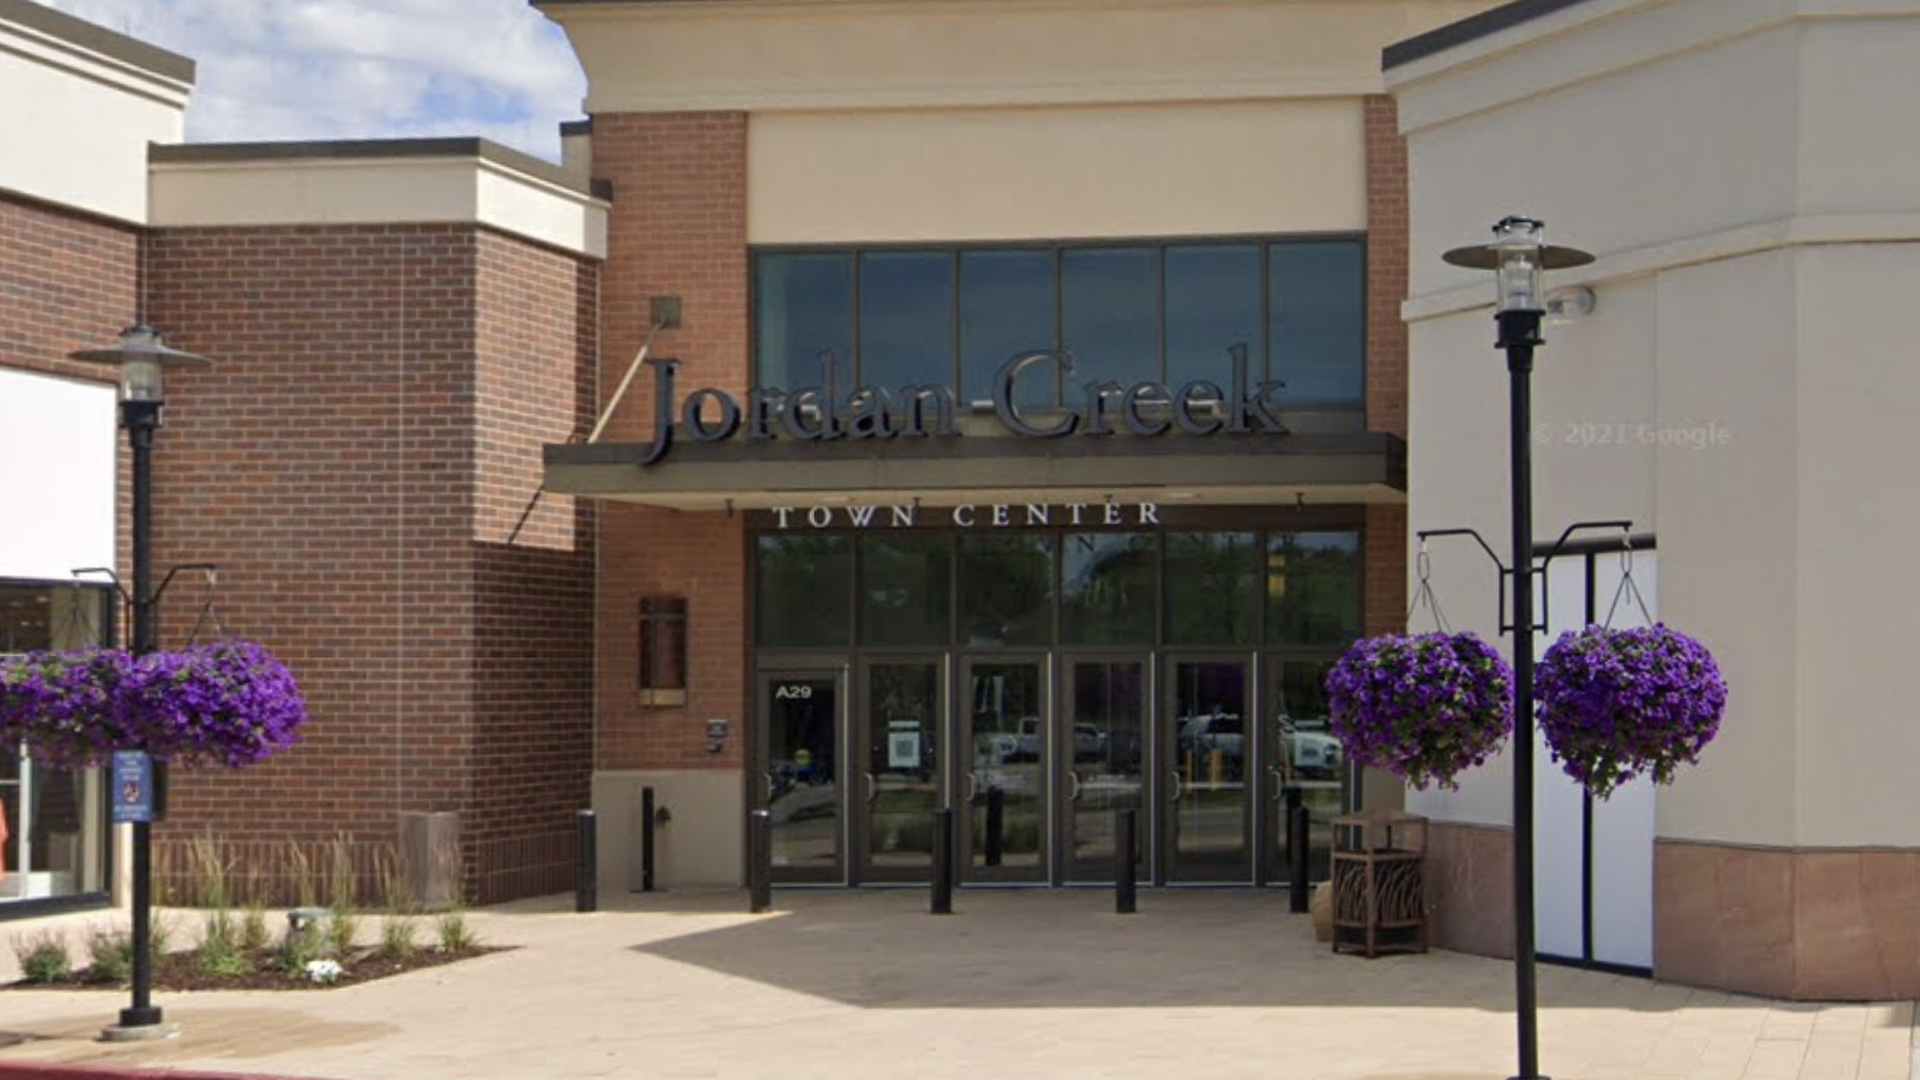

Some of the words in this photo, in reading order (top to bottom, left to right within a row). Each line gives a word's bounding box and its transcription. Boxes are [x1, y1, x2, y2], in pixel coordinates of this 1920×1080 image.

[639, 348, 963, 466] Jordan
[993, 342, 1290, 438] Creek
[772, 504, 915, 529] TOWN
[952, 501, 1160, 527] CENTER
[775, 685, 813, 699] A29
